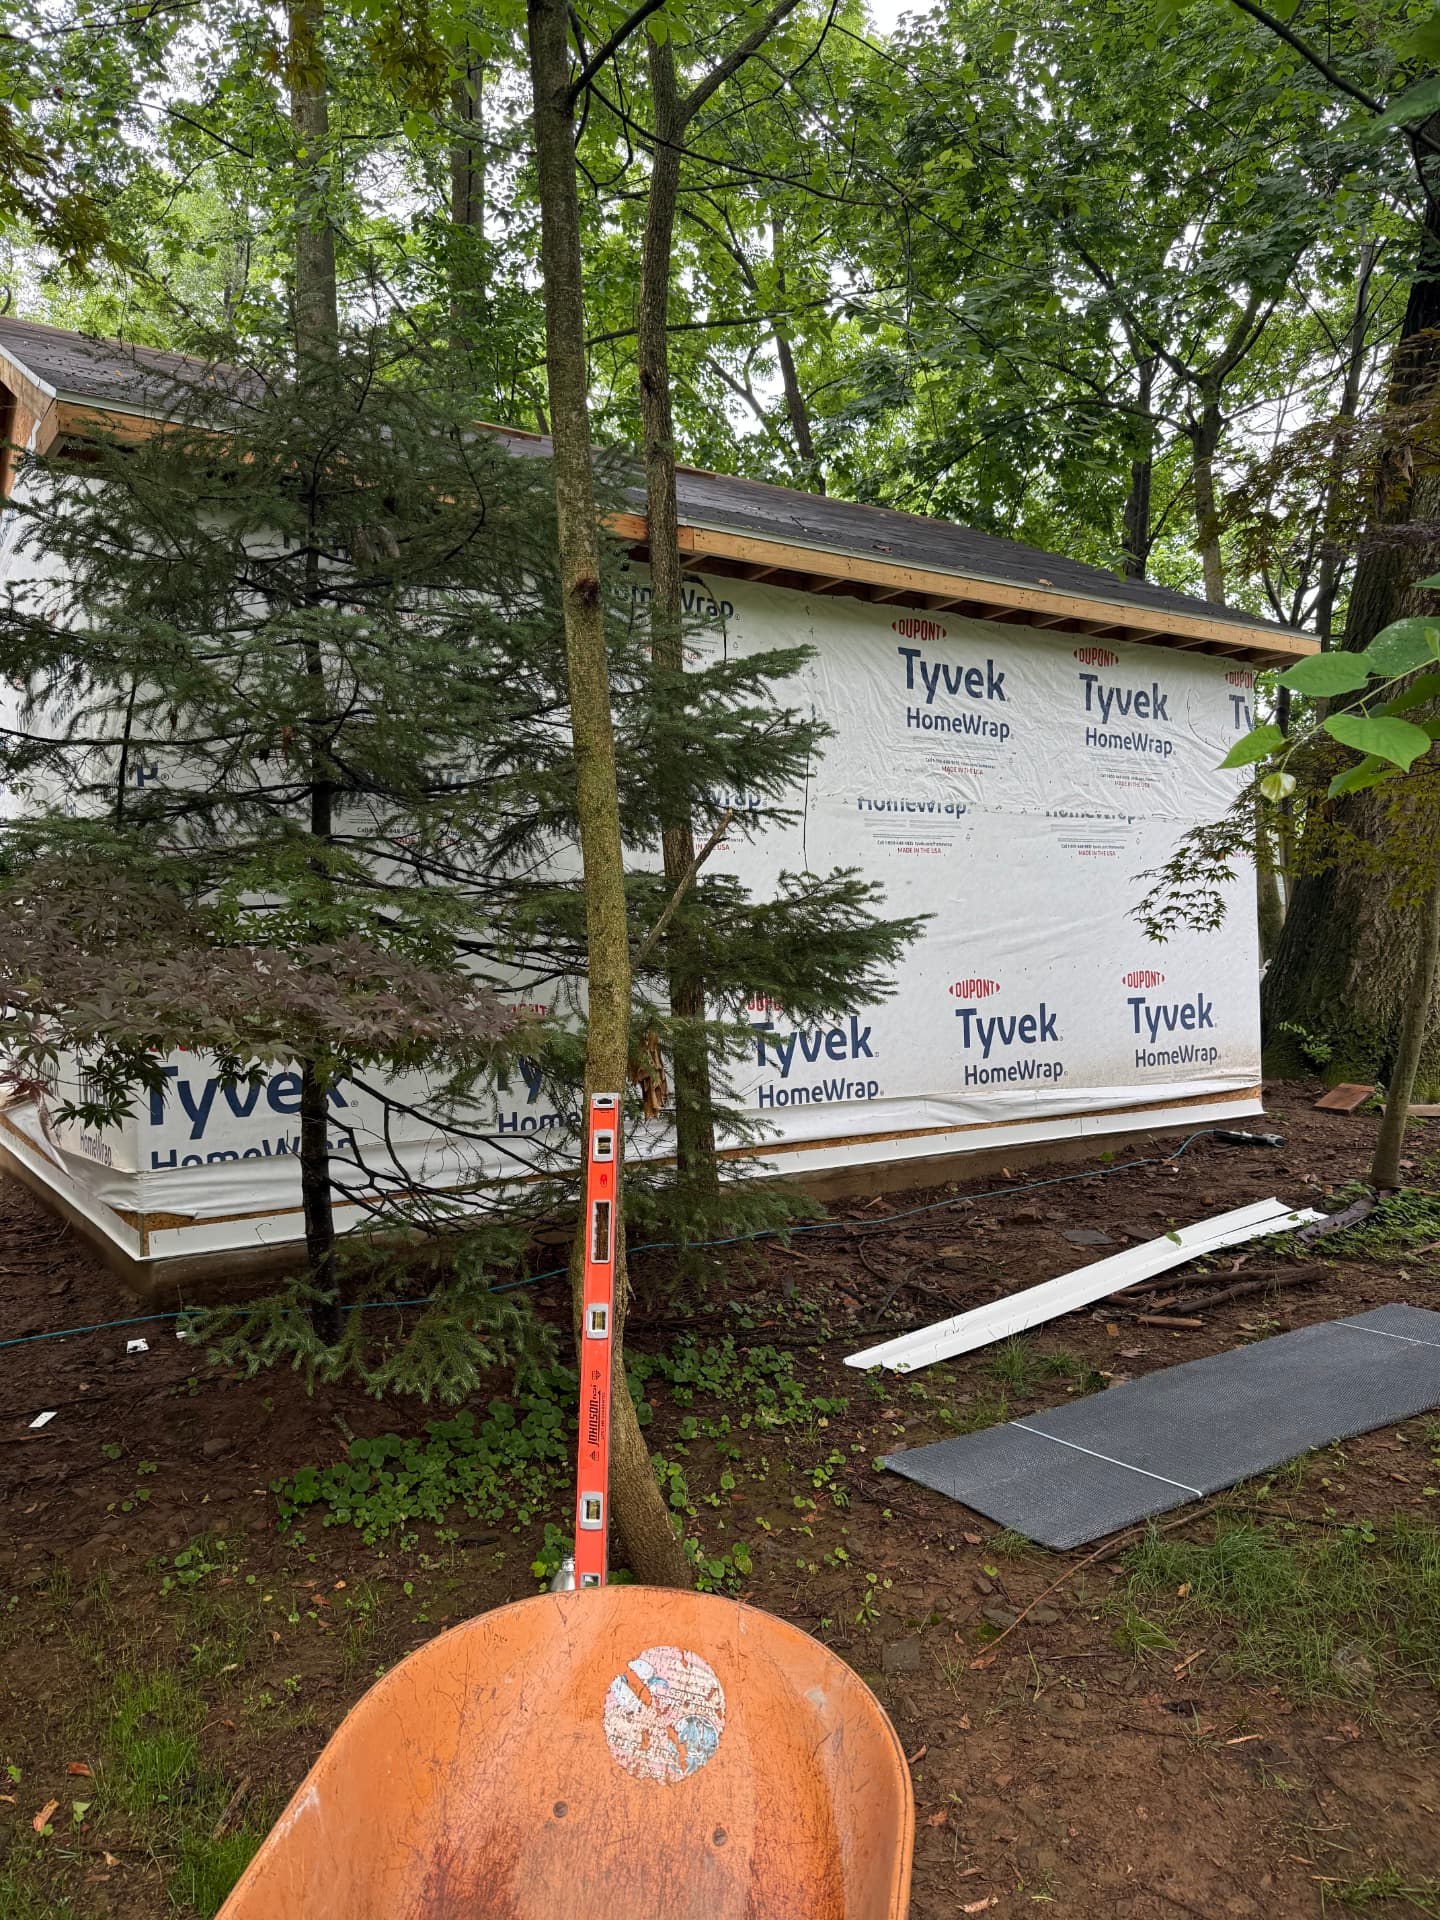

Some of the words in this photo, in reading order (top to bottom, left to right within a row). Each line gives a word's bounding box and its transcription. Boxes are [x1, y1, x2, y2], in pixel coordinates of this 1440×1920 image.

[899, 619, 942, 640] DUPONT
[1080, 647, 1115, 667] DUPONT
[898, 647, 1006, 704] Tyvek
[1079, 673, 1168, 724] Tyvek
[907, 706, 1010, 743] HomeWrap
[1086, 727, 1172, 758] HomeWrap
[955, 978, 995, 999] DUPONT
[1127, 970, 1161, 988] DUPONT
[955, 1002, 1058, 1059] Tyvek
[1127, 992, 1214, 1043] Tyvek
[1135, 1044, 1218, 1068] HomeWrap
[964, 1059, 1063, 1086] HomeWrap
[758, 1078, 879, 1109] HomeWrap
